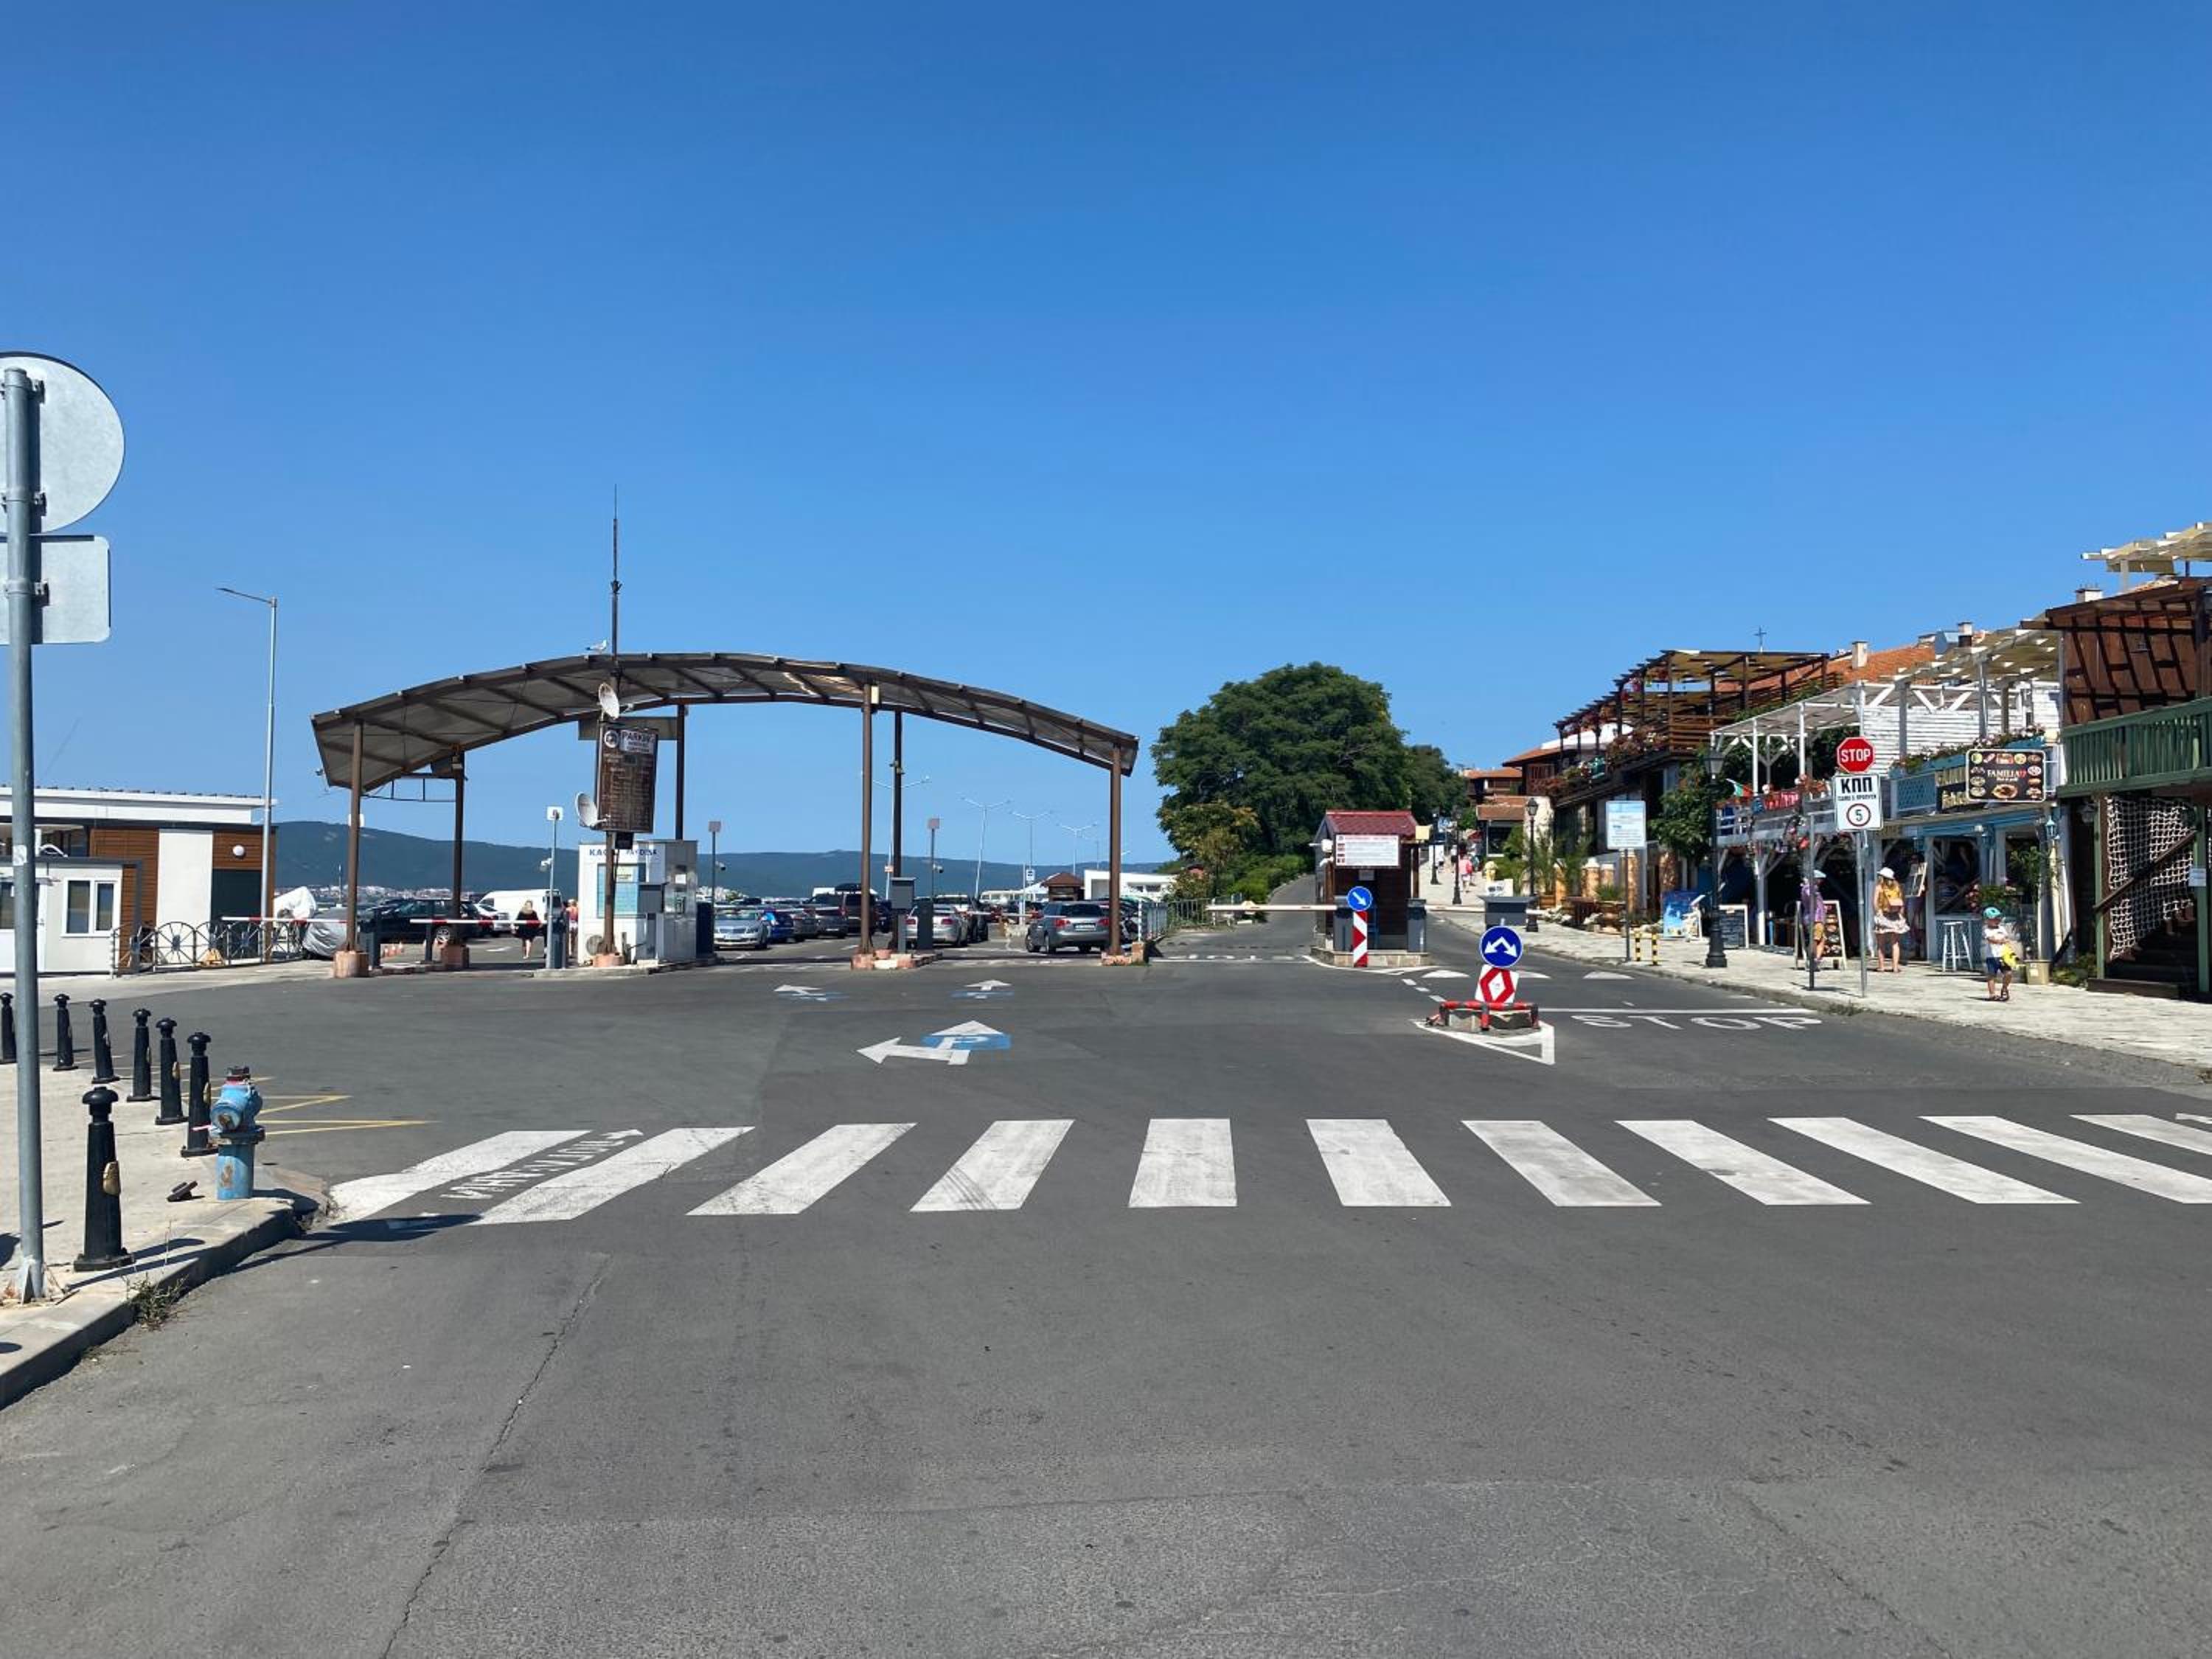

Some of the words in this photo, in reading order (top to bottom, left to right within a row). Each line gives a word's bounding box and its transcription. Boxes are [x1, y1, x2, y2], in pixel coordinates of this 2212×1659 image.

[1841, 748, 1871, 762] STOP
[1840, 776, 1872, 793] КПП
[1854, 809, 1863, 822] 5
[1571, 1014, 1823, 1031] STOP
